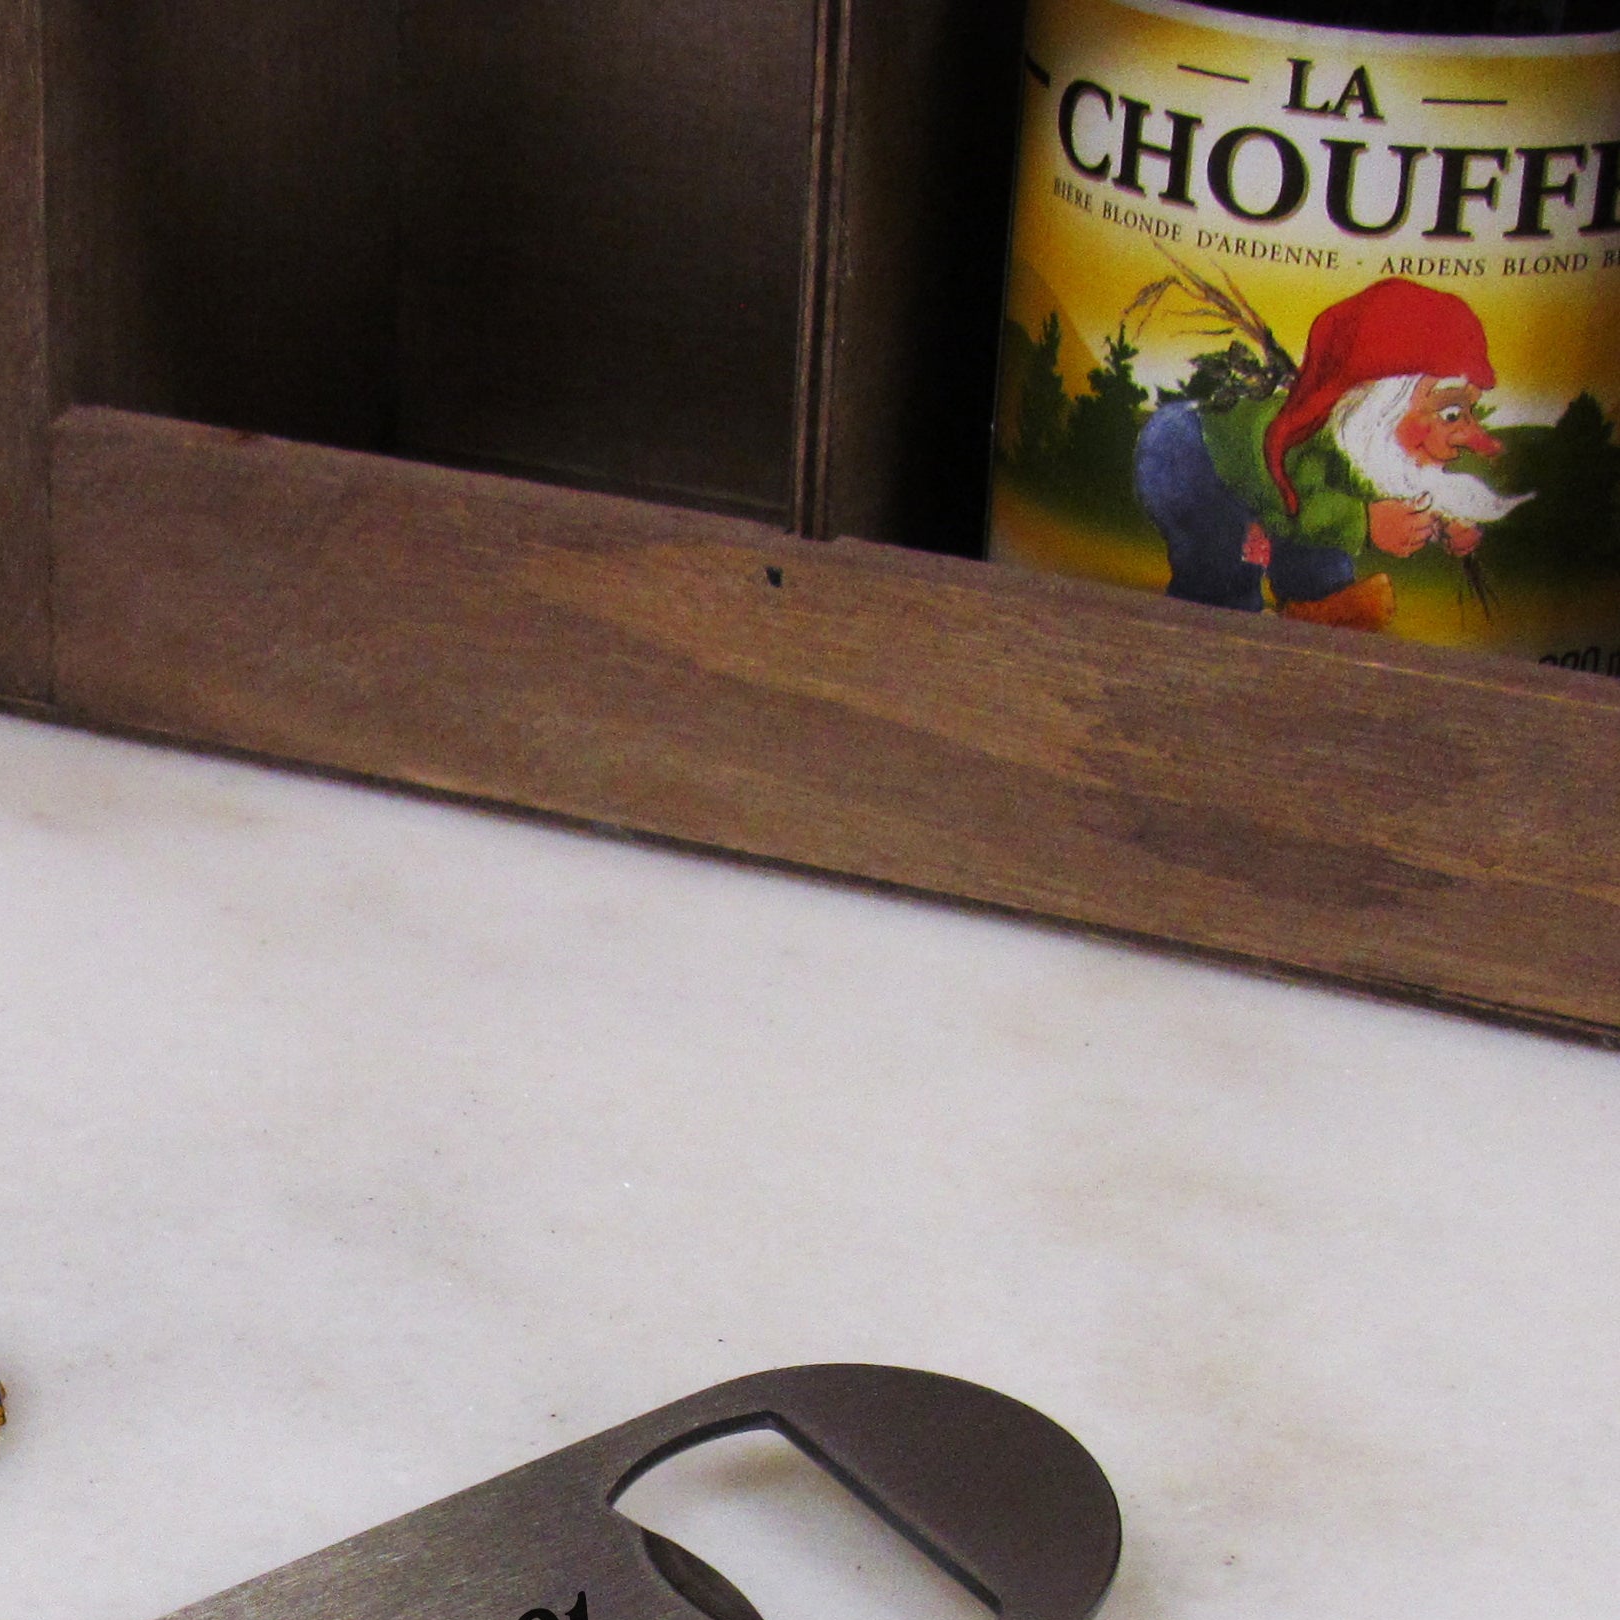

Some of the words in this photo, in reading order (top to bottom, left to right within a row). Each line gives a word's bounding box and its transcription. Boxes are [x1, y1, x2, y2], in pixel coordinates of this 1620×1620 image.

[1282, 56, 1385, 121] LA
[1101, 200, 1183, 243] BLONDE
[1195, 229, 1340, 271] D'ARDENNE
[1379, 255, 1487, 277] ARDENS
[1501, 252, 1589, 277] BLOND
